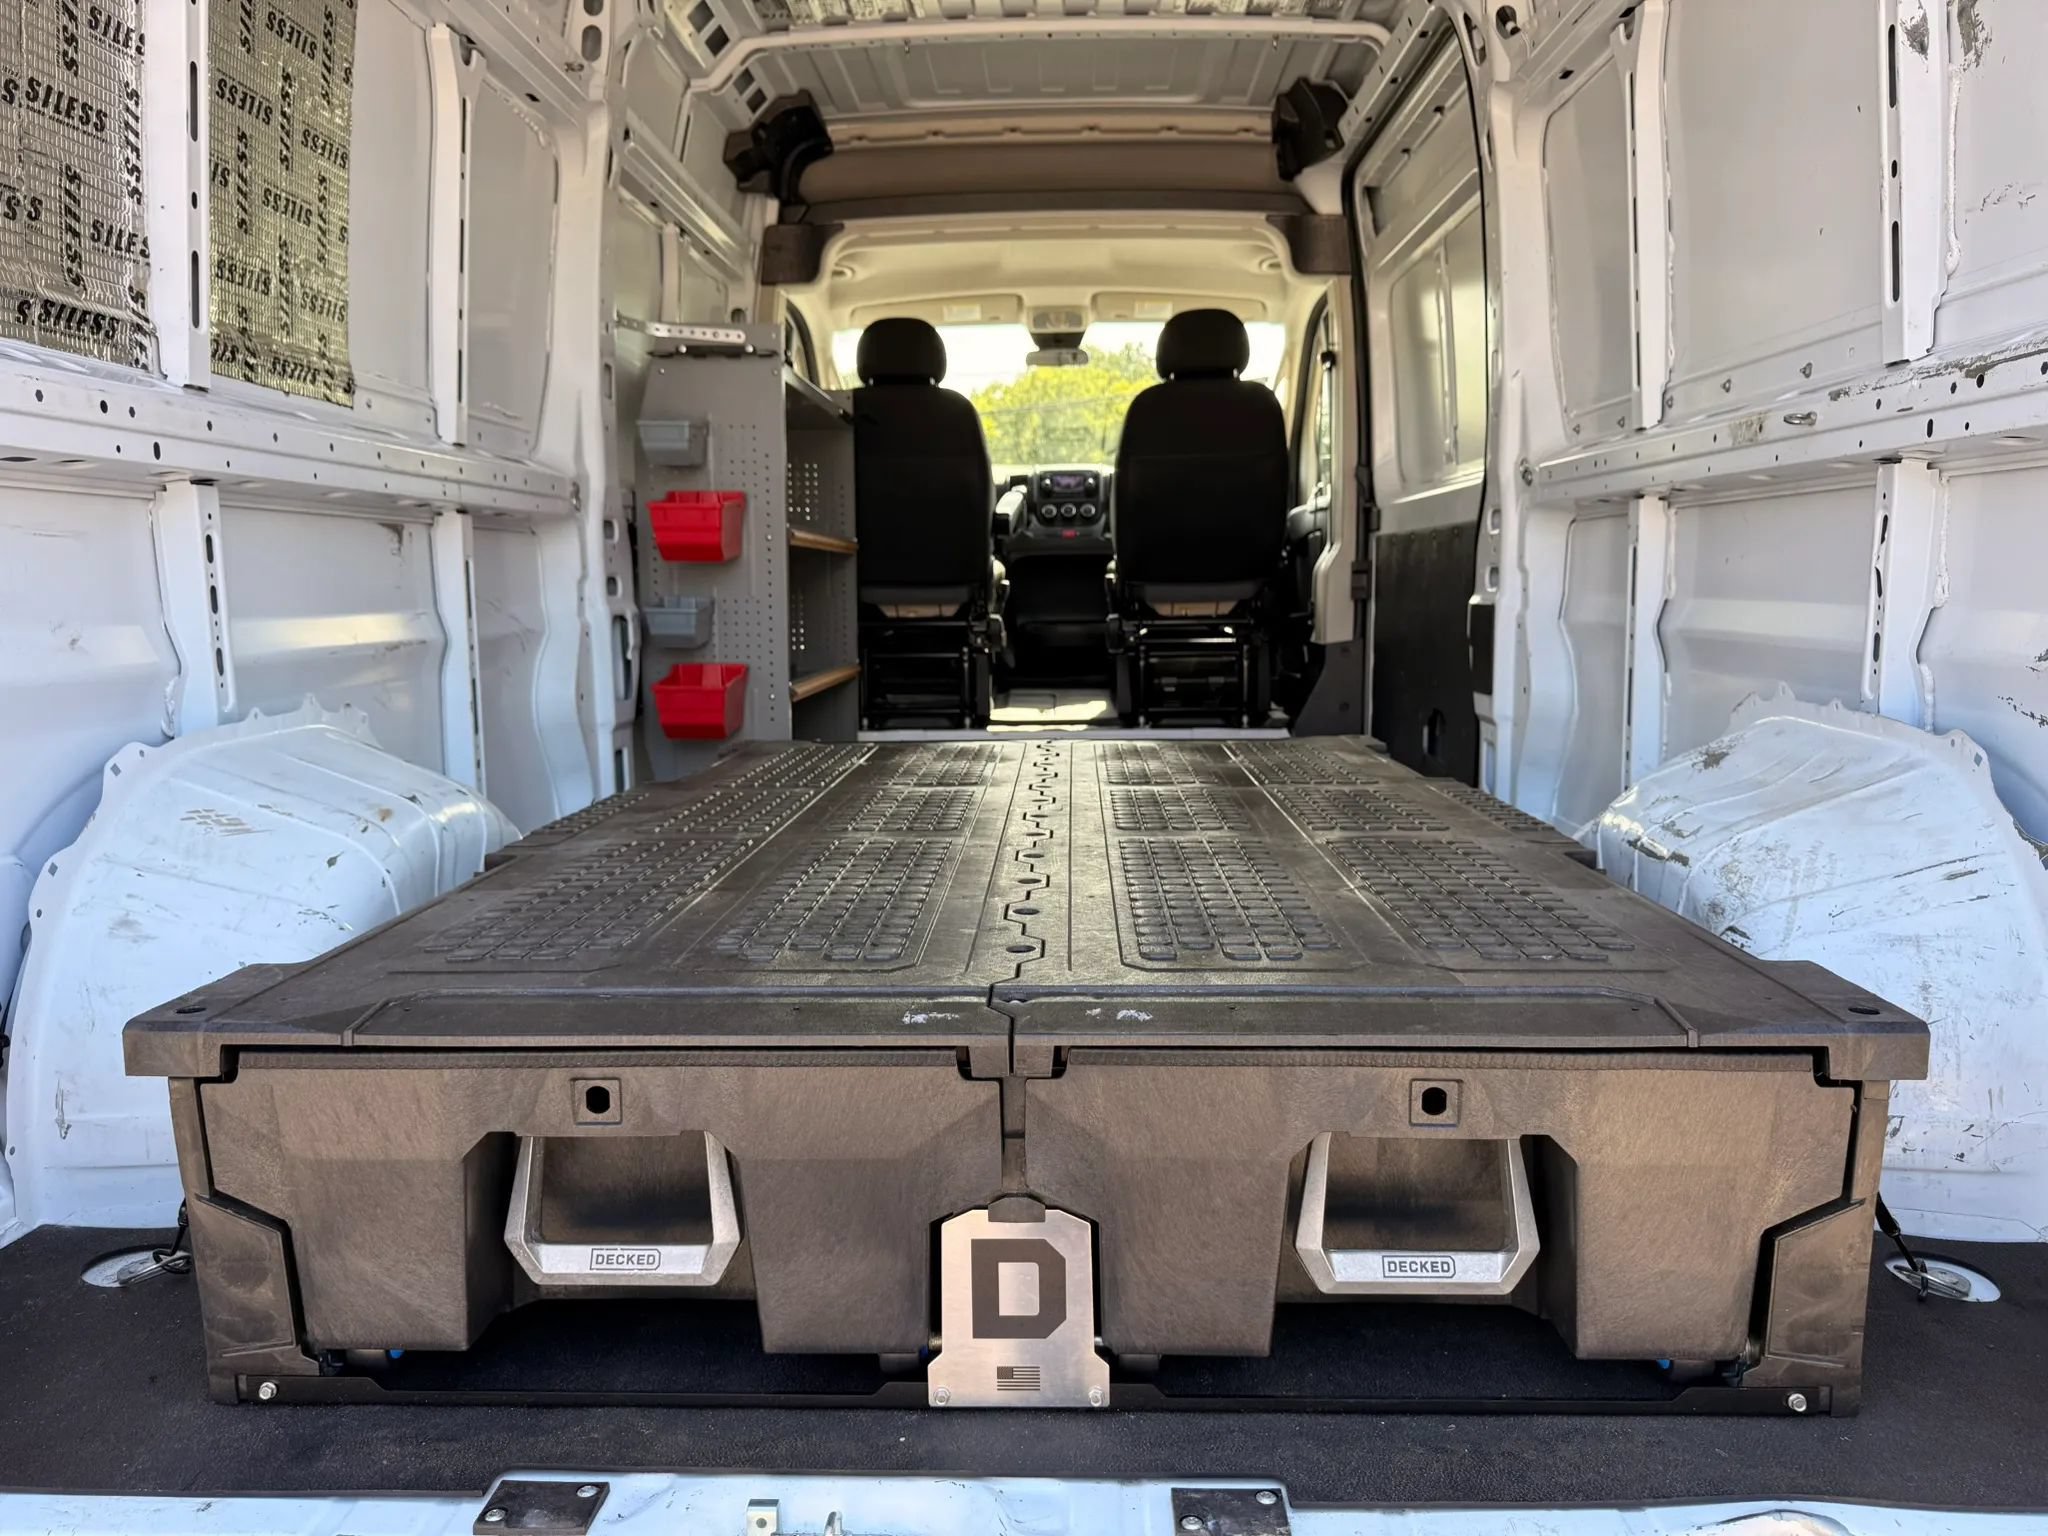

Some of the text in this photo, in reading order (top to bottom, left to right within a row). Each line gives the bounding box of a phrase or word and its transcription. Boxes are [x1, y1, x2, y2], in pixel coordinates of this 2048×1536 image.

[265, 11, 318, 61] SILESS
[25, 76, 108, 133] SILESS
[216, 78, 272, 126] SILESS
[123, 80, 142, 205] SILESS
[301, 129, 348, 170] SILESS
[64, 162, 86, 292] SILESS
[262, 187, 313, 228] SILESS
[37, 299, 121, 341] SILESS
[300, 290, 347, 323] SILESS
[595, 1253, 656, 1266] DECKED
[1387, 1260, 1451, 1273] DECKED
[970, 1238, 1067, 1339] D
